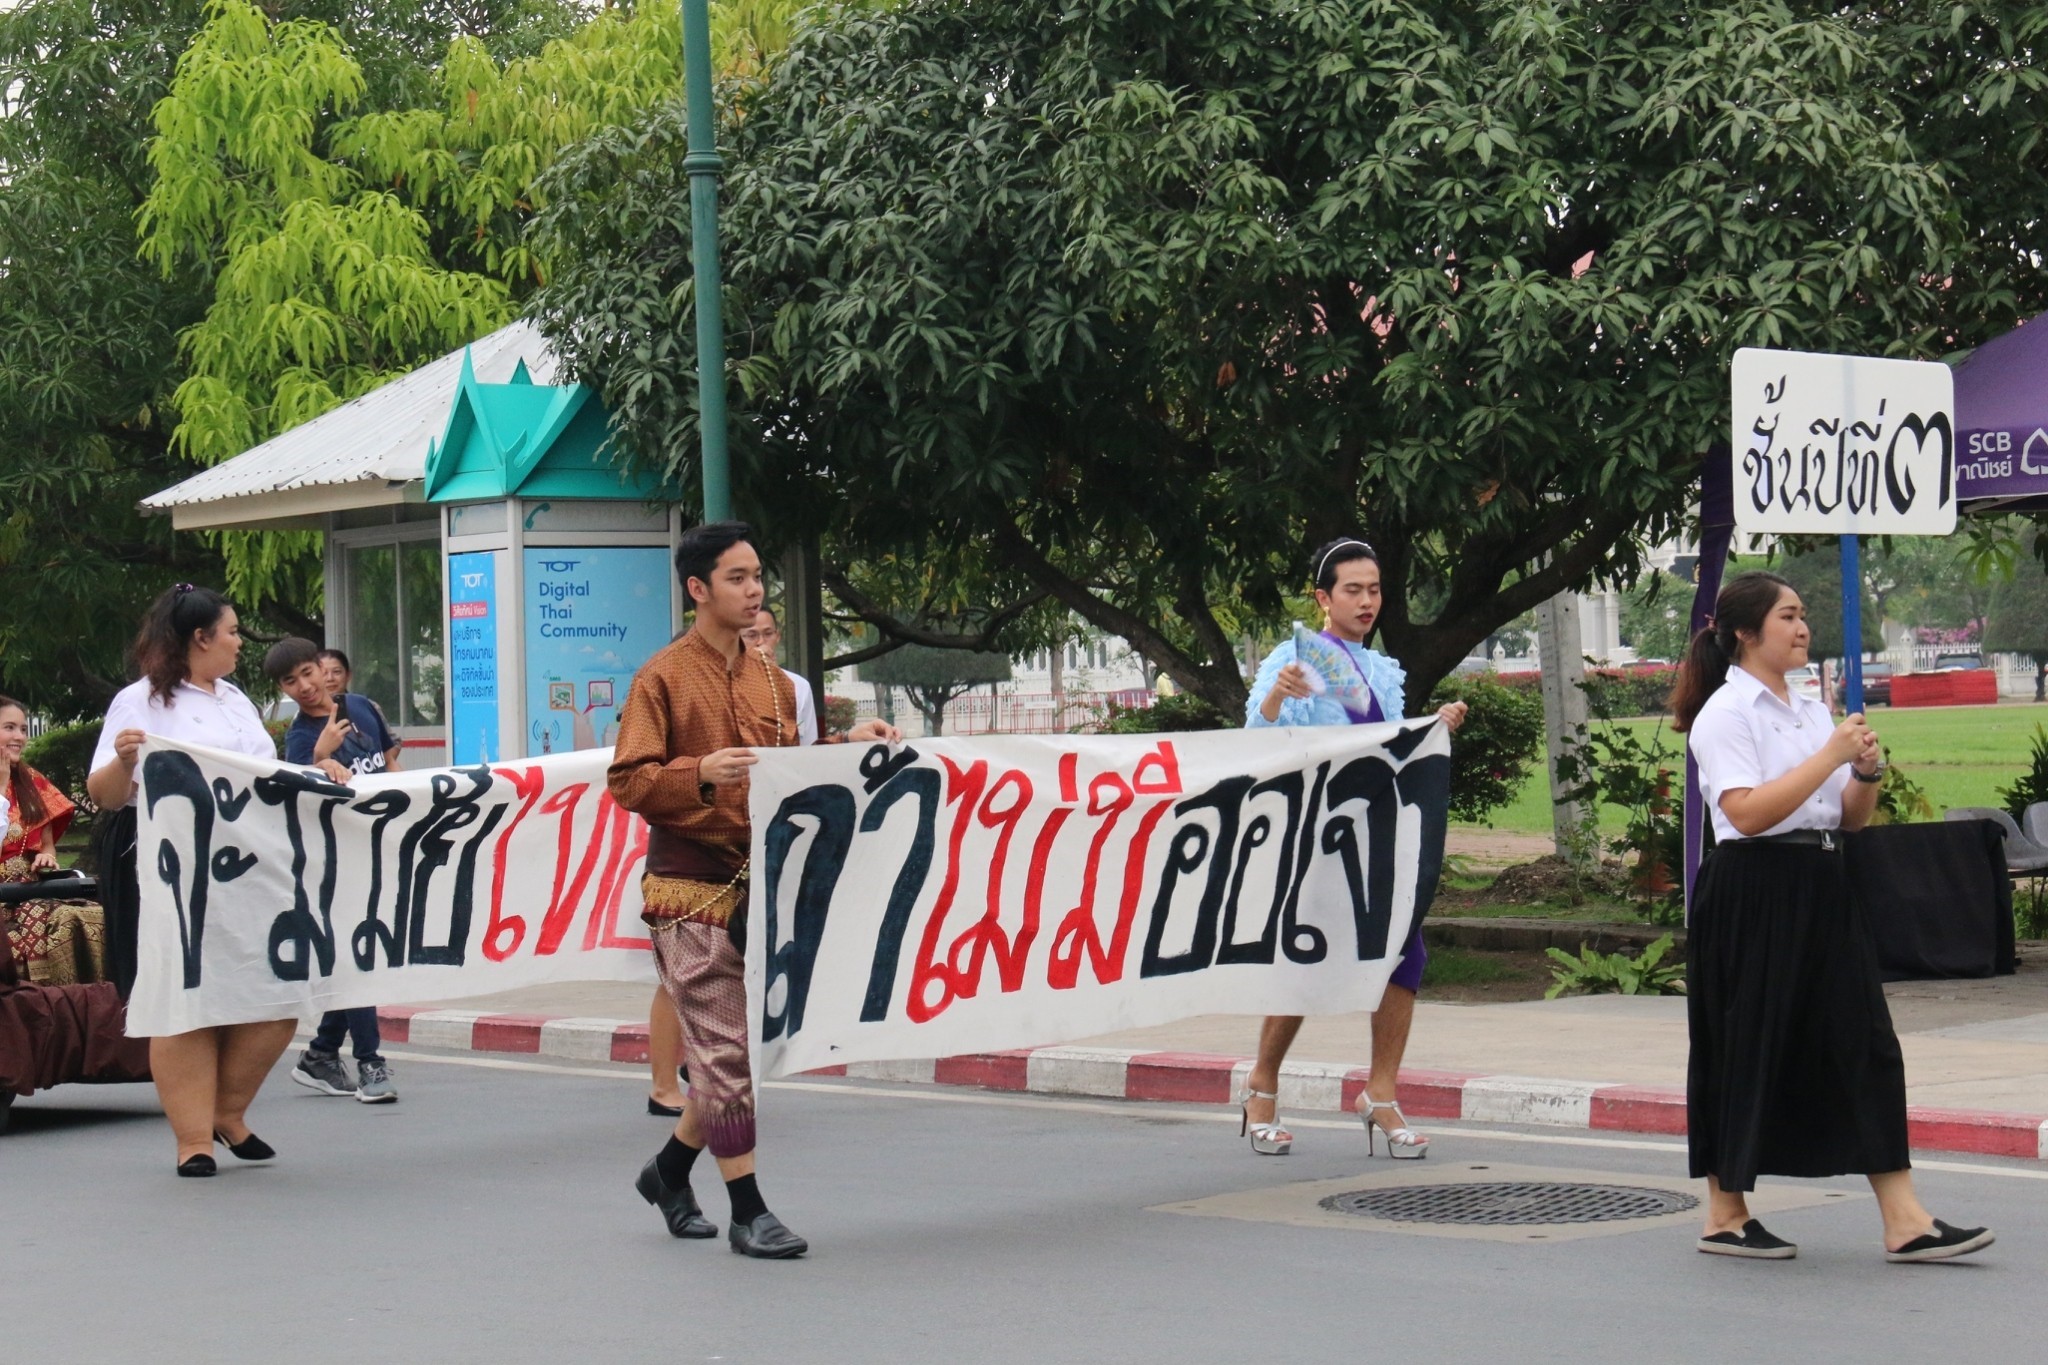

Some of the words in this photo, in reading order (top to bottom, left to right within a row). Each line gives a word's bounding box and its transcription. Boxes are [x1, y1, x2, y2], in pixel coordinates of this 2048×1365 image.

[1742, 374, 1952, 516] ชั้นปีที่๓
[1969, 431, 2012, 454] SCB
[1955, 454, 2013, 482] าณิชย์
[538, 561, 582, 573] TOT
[461, 573, 485, 587] TOT
[540, 580, 590, 601] Digital
[539, 602, 572, 619] Thai
[540, 622, 628, 642] Community
